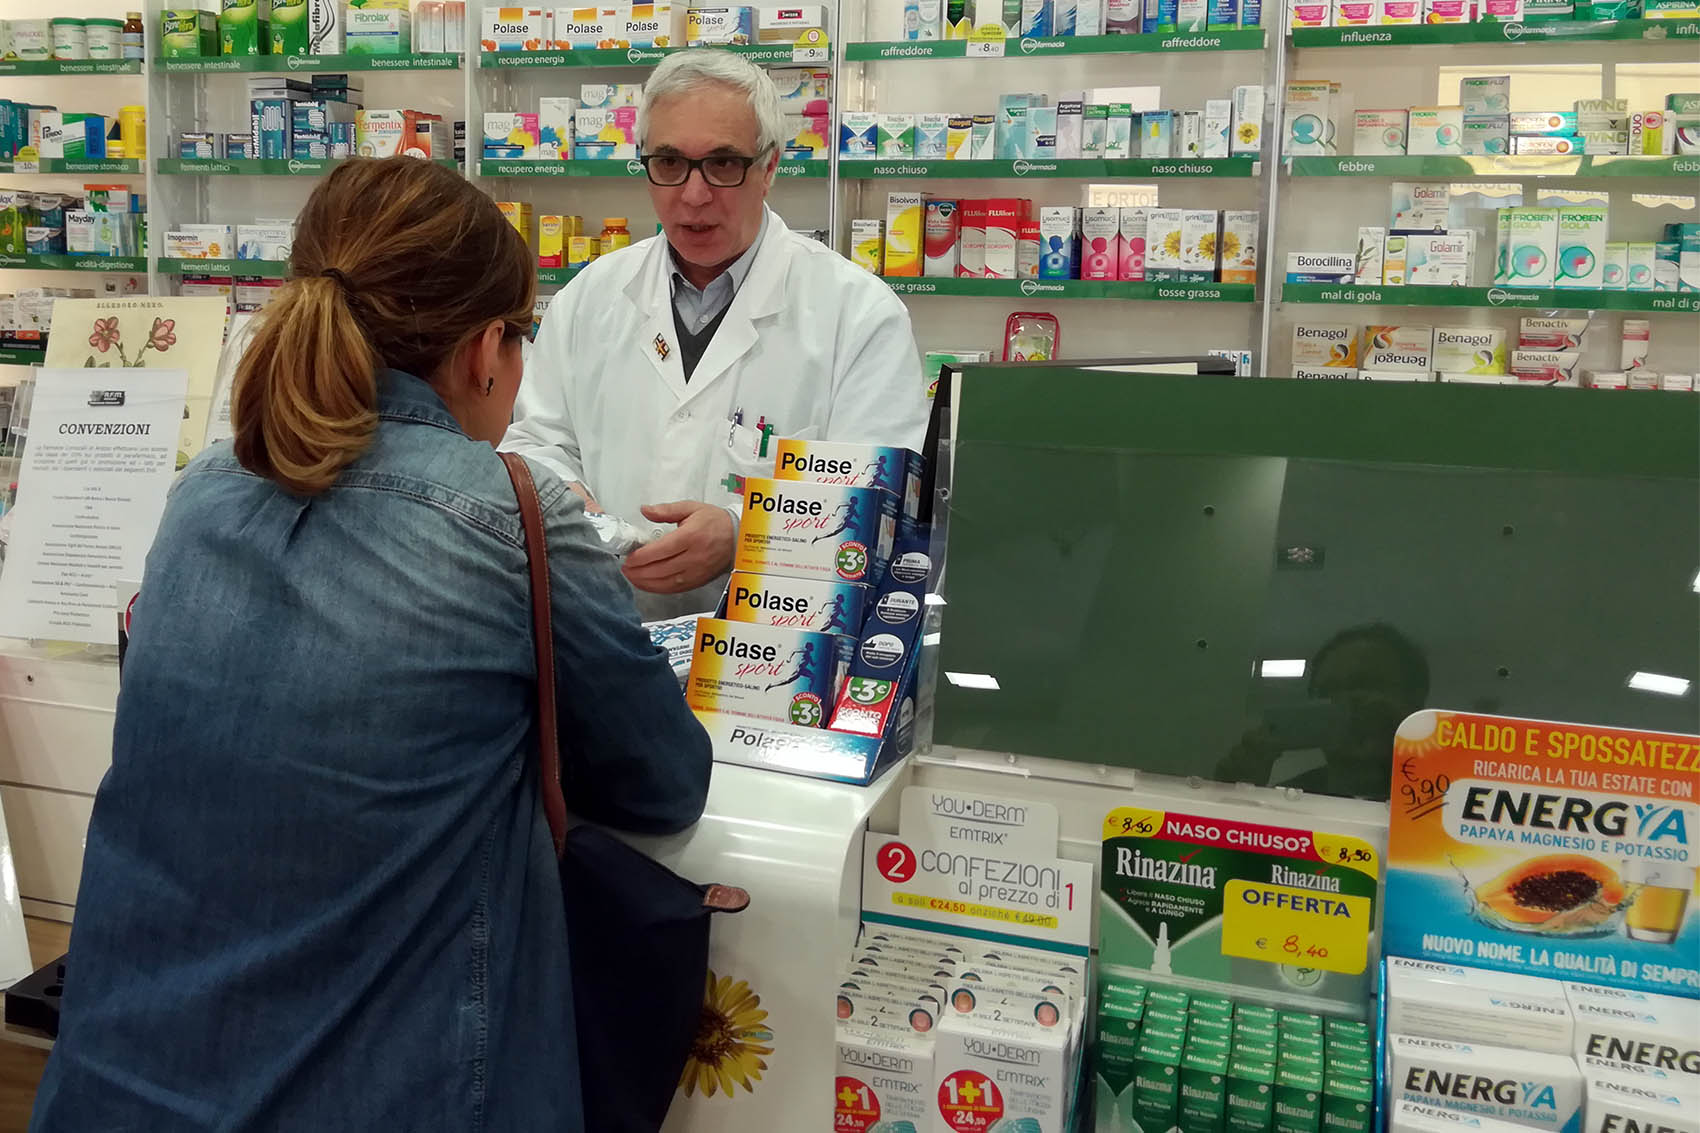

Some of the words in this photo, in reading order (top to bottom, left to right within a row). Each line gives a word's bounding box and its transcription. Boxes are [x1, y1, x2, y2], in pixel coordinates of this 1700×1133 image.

[354, 12, 390, 23] Fibrolax
[689, 15, 723, 26] Polase
[493, 23, 529, 34] Polase
[566, 23, 603, 34] Polase
[626, 21, 659, 32] Polase
[1162, 36, 1221, 48] raffreddore
[1341, 31, 1392, 42] influenza
[881, 46, 932, 57] raffreddore
[167, 61, 202, 71] benessere
[203, 60, 241, 70] intestinale
[371, 58, 410, 68] benessere
[412, 57, 453, 67] intestinale
[498, 55, 534, 66] recupero
[534, 55, 565, 66] energia
[60, 62, 94, 73] benessere
[96, 62, 131, 74] intestinale
[487, 120, 510, 131] mag
[579, 115, 603, 126] mag
[65, 162, 100, 170] benessere
[100, 163, 129, 171] stomaco
[180, 163, 209, 171] fermenti
[211, 163, 230, 172] lattici
[498, 165, 533, 175] recupero
[534, 164, 565, 175] energia
[873, 165, 896, 175] naso
[897, 164, 928, 175] chiuso
[1151, 165, 1177, 174] naso
[1178, 163, 1213, 174] chiuso
[1338, 160, 1375, 172] febbre
[1414, 186, 1448, 199] Golamir
[889, 196, 919, 205] Bisolvon
[68, 214, 96, 225] Mayday
[1513, 214, 1554, 222] FROBEN
[1561, 214, 1603, 222] FROBEN
[1560, 222, 1590, 230] GOLA
[1430, 240, 1464, 253] Golamir
[180, 262, 209, 271] fermenti
[210, 262, 231, 272] lattici
[1297, 256, 1353, 268] Borocillina
[1158, 288, 1187, 298] tosse
[1187, 289, 1221, 300] grassa
[1321, 290, 1342, 300] mal
[1344, 290, 1355, 300] di
[1357, 290, 1382, 303] gola
[1653, 298, 1675, 308] mal
[1678, 298, 1689, 309] di
[1525, 318, 1569, 329] Benactiv
[1296, 327, 1348, 341] Benagol
[1437, 332, 1493, 346] Benagol
[1373, 353, 1427, 367] Benagol
[1516, 352, 1561, 363] Benactiv
[58, 423, 151, 436] CONVENZIONI
[781, 452, 852, 475] Polase
[748, 491, 823, 517] Polase
[783, 513, 831, 534] sport
[734, 587, 809, 614] Polase
[770, 611, 817, 627] sport
[700, 633, 777, 662] Polase
[735, 660, 786, 680] sport
[1437, 719, 1517, 754] CALDO
[1525, 728, 1541, 756] E
[1473, 759, 1541, 783] RICARICA
[1546, 767, 1566, 785] LA
[1569, 769, 1598, 788] TUA
[1602, 773, 1657, 795] ESTATE
[1660, 778, 1693, 798] CON
[1400, 773, 1450, 806] 9,90
[950, 826, 1003, 845] EMTRIX
[1166, 820, 1221, 842] NASO
[1225, 829, 1311, 853] CHIUSO?
[1459, 823, 1516, 843] PAPAYA
[1520, 831, 1596, 852] MAGNESIO
[1601, 840, 1610, 853] E
[1615, 842, 1689, 863] POTASSIO
[887, 847, 906, 879] 2
[920, 849, 1061, 891] CONFEZIONI
[1115, 846, 1217, 890] Rinazina
[1271, 864, 1342, 893] Rinazina
[958, 878, 973, 896] al
[978, 884, 1038, 906] prezzo
[1045, 893, 1060, 910] di
[1065, 882, 1074, 911] 1
[1154, 892, 1176, 902] NASO
[1176, 896, 1206, 906] CHIUSO
[1151, 900, 1204, 915] RAPIDAMENTE
[1241, 888, 1352, 918] OFFERTA
[1158, 908, 1185, 918] LUNGO
[1282, 934, 1329, 958] 8,40
[1422, 934, 1474, 956] NUOVO
[1530, 948, 1550, 967] LA
[1552, 952, 1617, 977] QUALITÀ
[1620, 961, 1638, 978] DI
[1641, 965, 1700, 989] SEMPR
[1586, 1032, 1700, 1076] ENERG
[996, 1069, 1046, 1088] EMTRIX
[872, 1077, 920, 1094] EMTRIX
[944, 1077, 993, 1107] 1+1
[1508, 1108, 1558, 1123] POTASSIO
